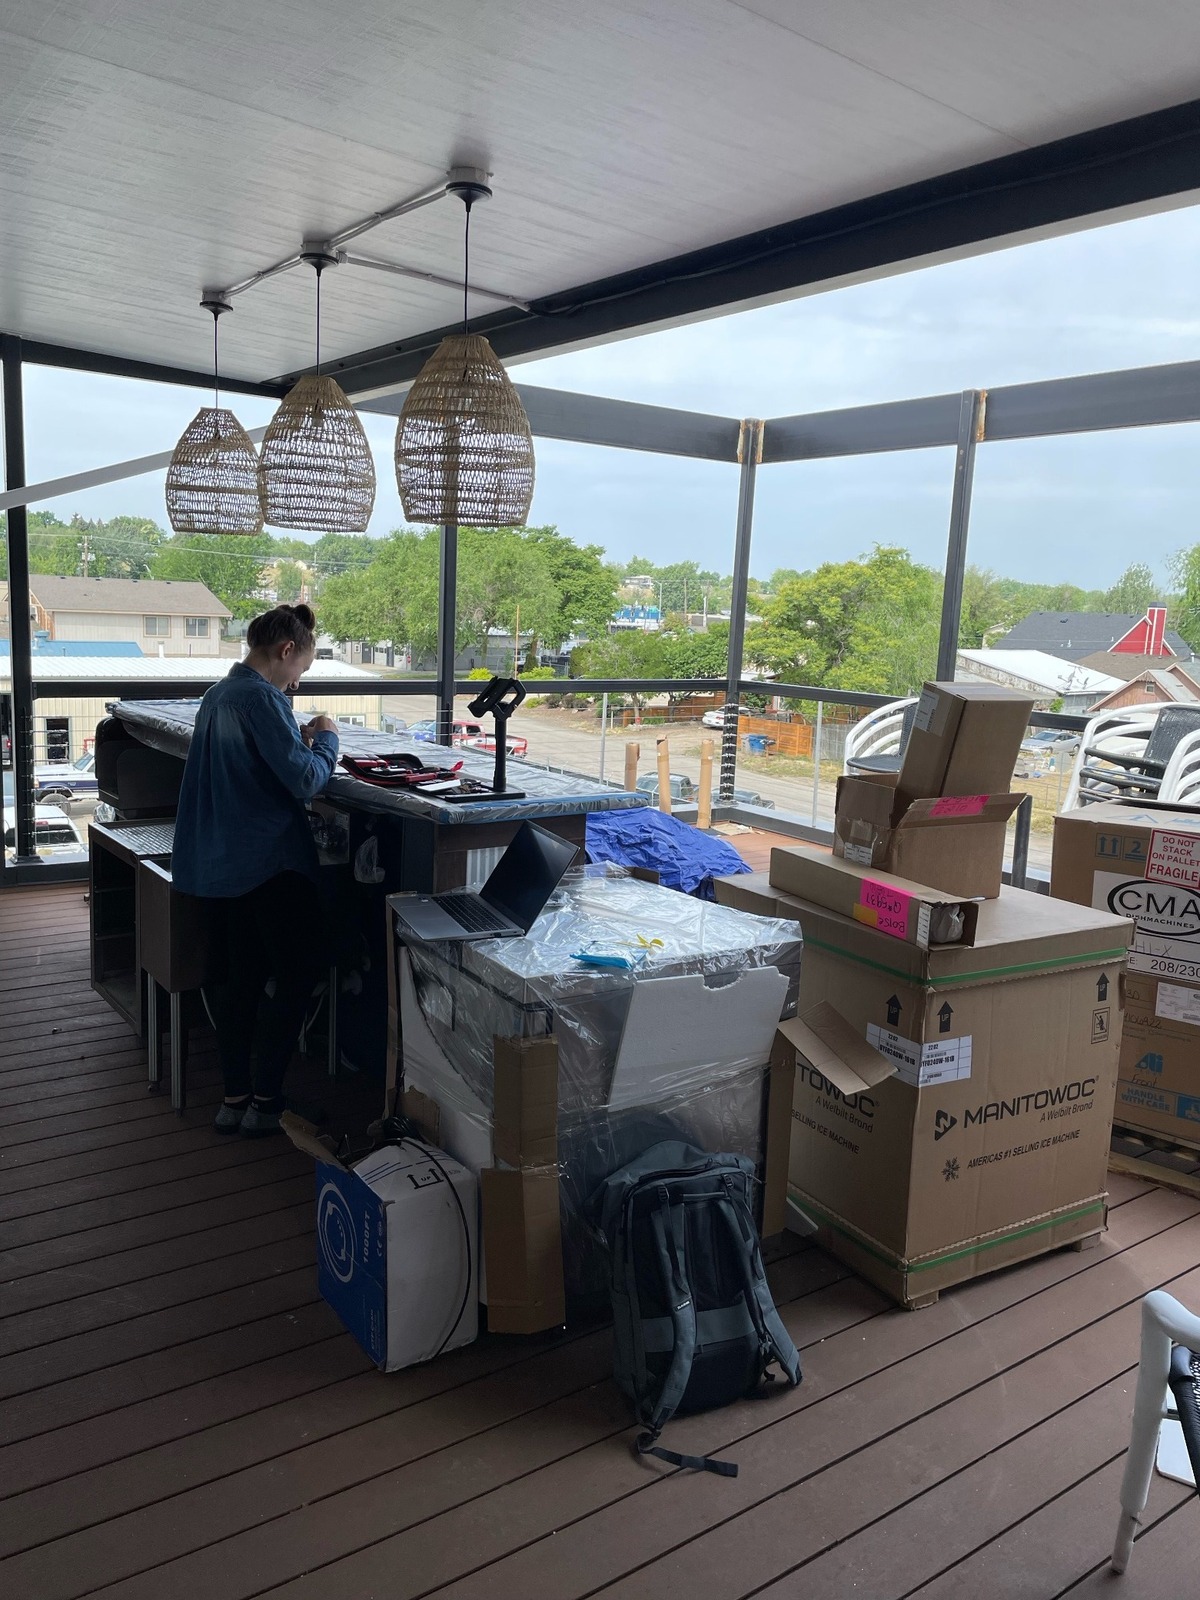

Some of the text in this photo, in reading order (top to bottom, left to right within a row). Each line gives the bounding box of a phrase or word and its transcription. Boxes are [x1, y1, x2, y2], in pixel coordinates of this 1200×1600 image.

[1162, 836, 1196, 848] DO NOT
[1162, 845, 1193, 857] STACK
[1152, 852, 1200, 867] ON PALLET
[1149, 863, 1199, 883] FRAGILE
[1118, 889, 1200, 922] CMA
[963, 1078, 1096, 1129] MANITOWOC
[1121, 1092, 1171, 1112] WITH CARE
[1126, 1087, 1165, 1102] HANDLE
[822, 1099, 848, 1120] Welbilt
[849, 1113, 874, 1133] Brand
[1047, 1105, 1071, 1121] Welbilt
[1071, 1099, 1094, 1114] Brand
[791, 1109, 860, 1155] SELLING ICE MACHINE
[967, 1129, 1081, 1169] AMERICAS #1 SELLING ICE MACHINE
[362, 1210, 371, 1263] 1000FT
